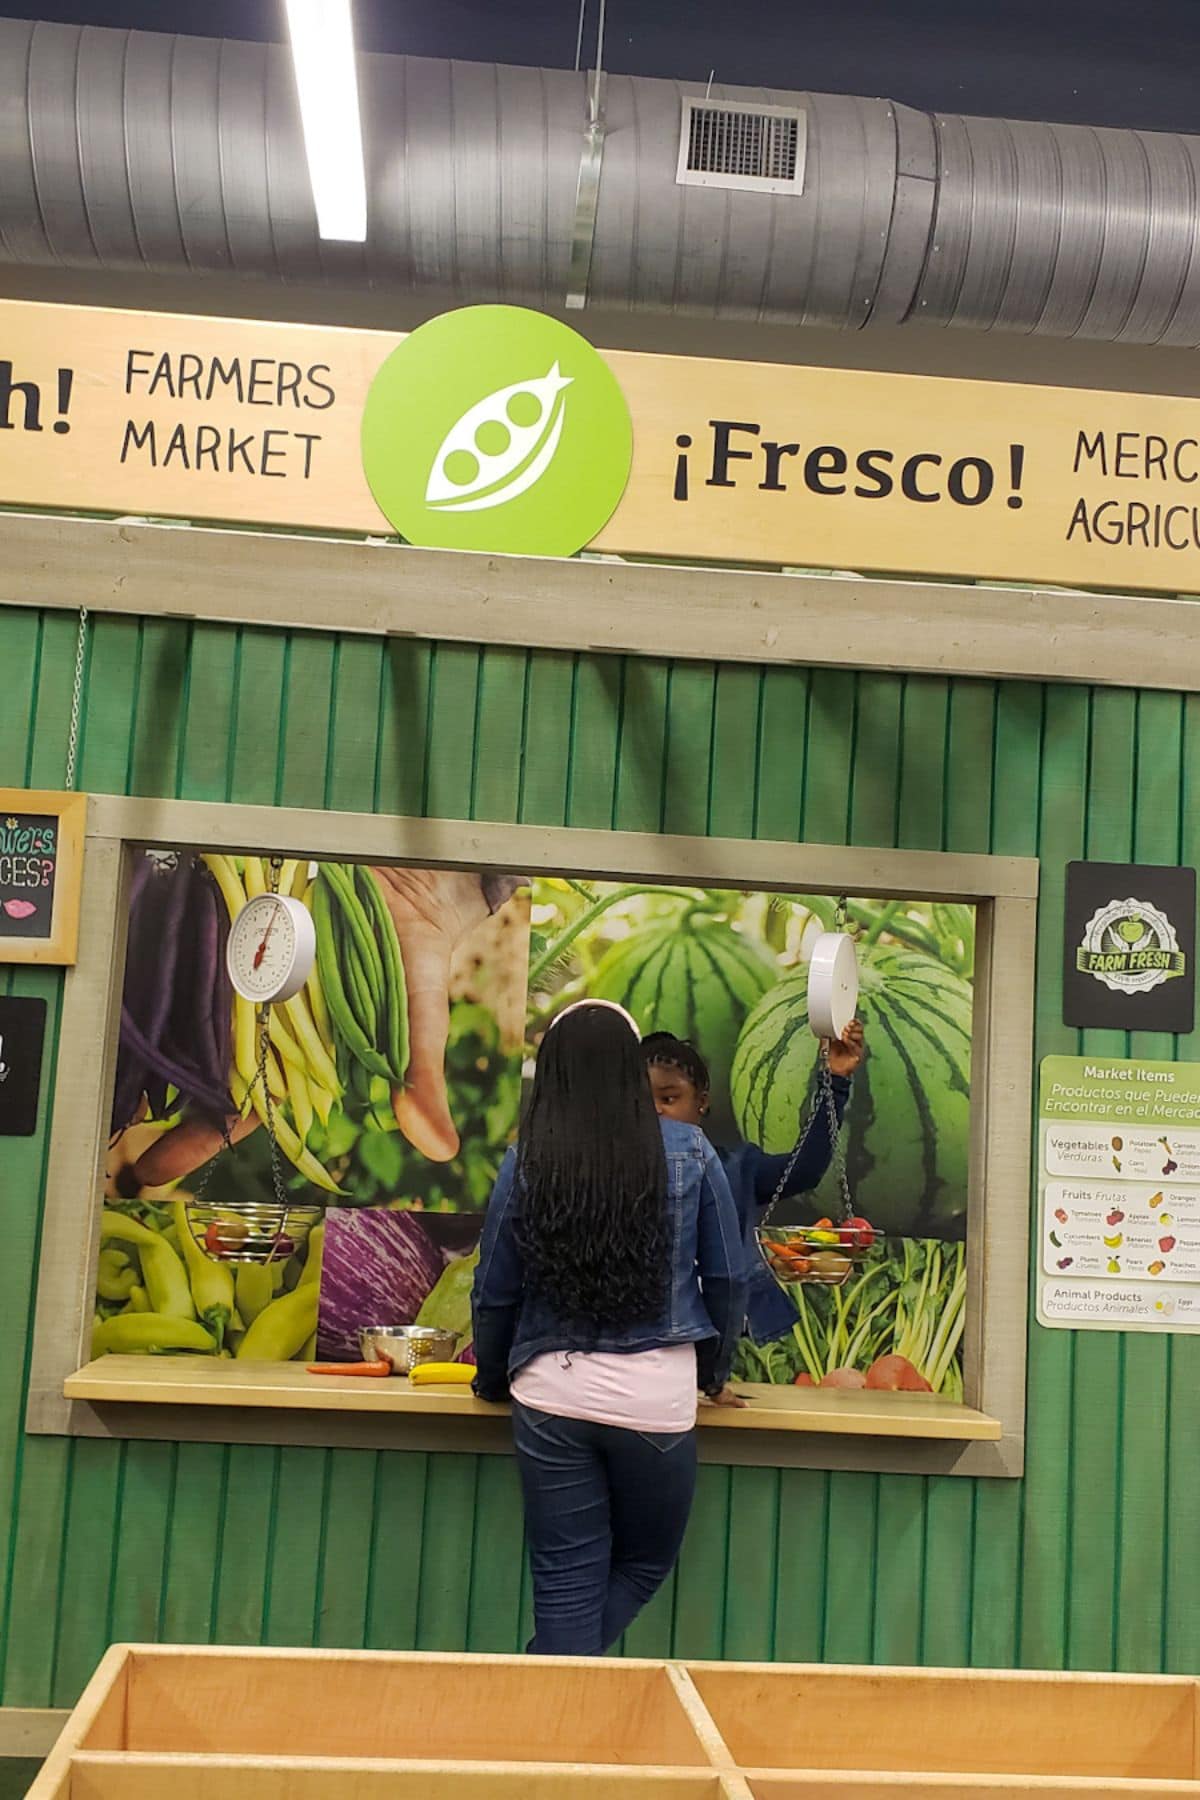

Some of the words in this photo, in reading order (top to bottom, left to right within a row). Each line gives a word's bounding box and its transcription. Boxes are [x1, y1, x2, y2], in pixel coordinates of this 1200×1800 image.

[124, 350, 336, 409] FARMERS
[120, 420, 322, 479] MARKET
[1073, 430, 1198, 483] MERC
[673, 420, 1025, 510] ¡Fresco!
[0, 856, 54, 887] CES?
[1088, 954, 1127, 971] FARM
[1129, 951, 1171, 969] FRESH
[1084, 1065, 1133, 1081] Market
[1136, 1069, 1175, 1083] Items
[1051, 1083, 1121, 1099] Productos
[1124, 1090, 1151, 1102] que
[1045, 1098, 1112, 1114] Encontrar
[1115, 1104, 1133, 1115] en
[1136, 1104, 1148, 1116] el
[1051, 1139, 1110, 1152] Vegetables
[1057, 1151, 1104, 1162] Verduras
[1062, 1189, 1092, 1200] Fruits
[1094, 1190, 1127, 1202] Frutas
[1054, 1288, 1091, 1299] Animal
[1094, 1290, 1142, 1302] Products
[1046, 1300, 1100, 1313] Productos
[1102, 1303, 1149, 1314] Animales
